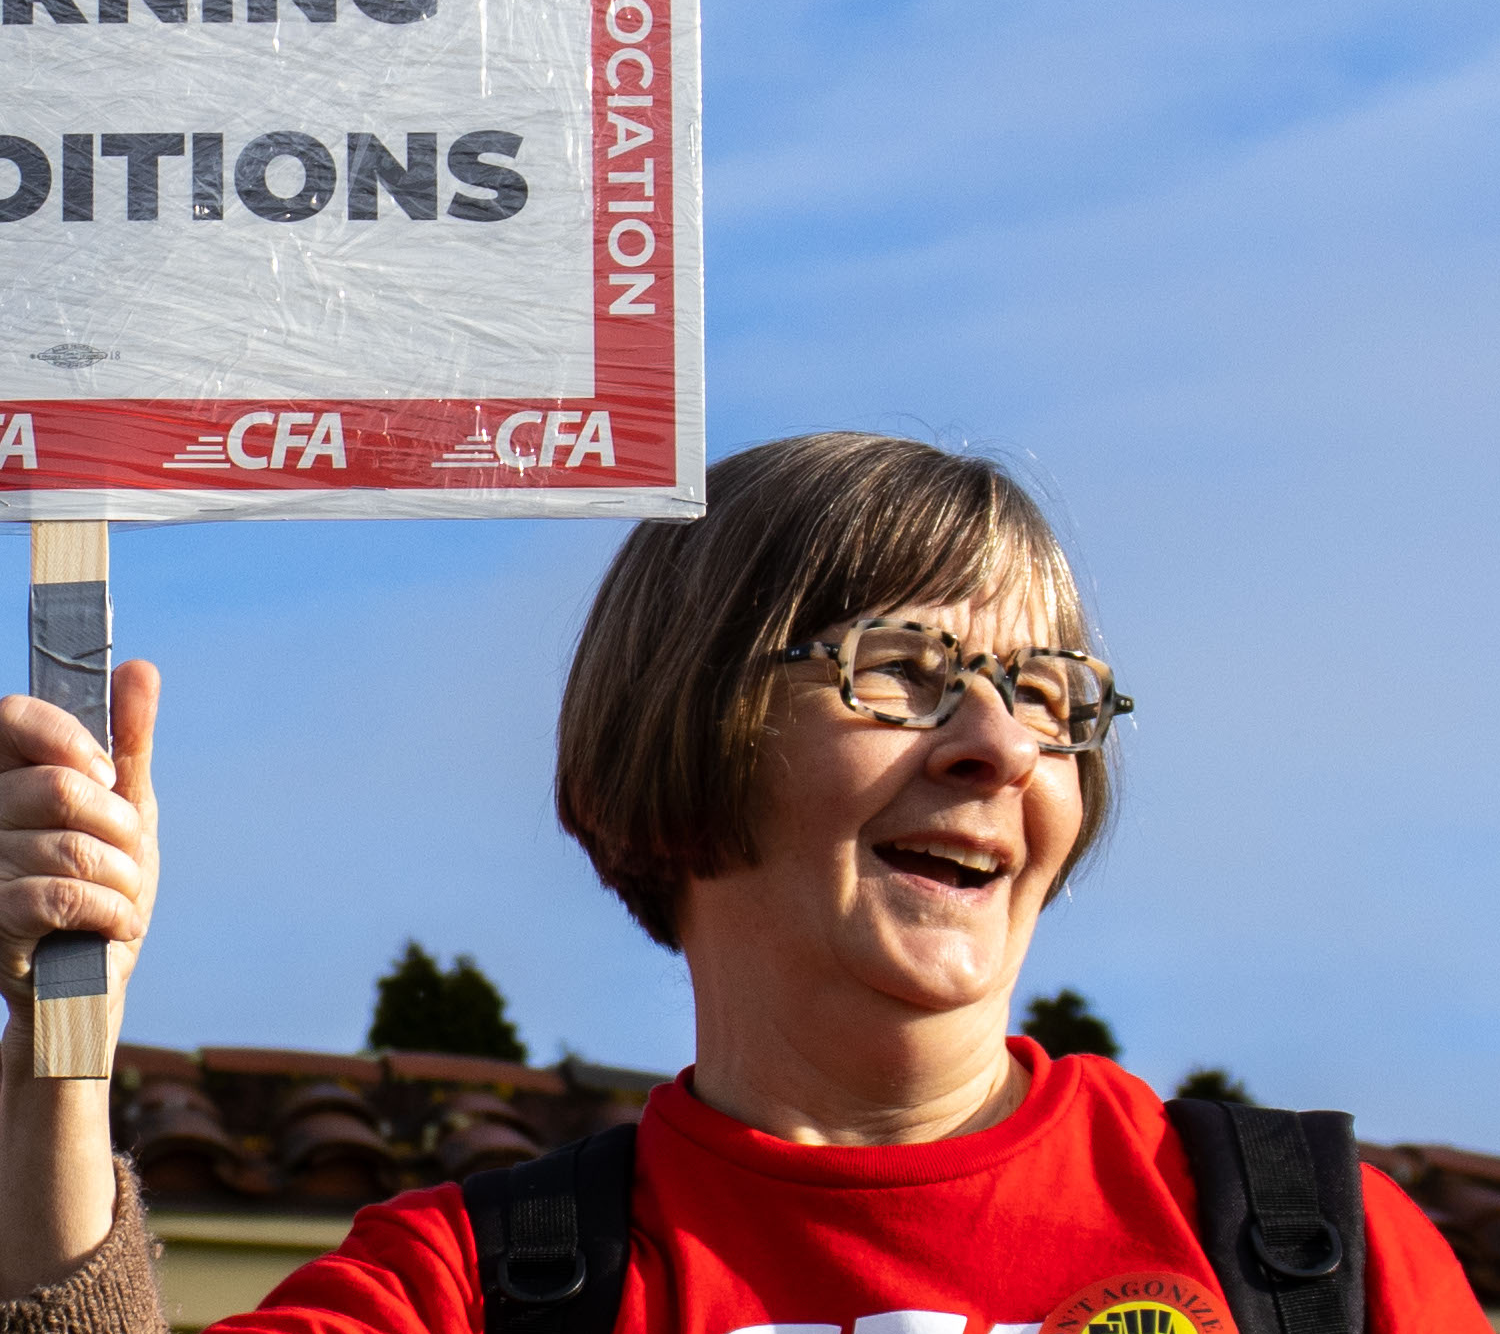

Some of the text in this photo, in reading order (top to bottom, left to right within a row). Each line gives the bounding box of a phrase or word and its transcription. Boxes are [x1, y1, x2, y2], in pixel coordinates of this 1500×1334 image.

[226, 410, 348, 470] CFA
[494, 409, 618, 468] CFA
[1102, 1279, 1224, 1334] AGONIZE
